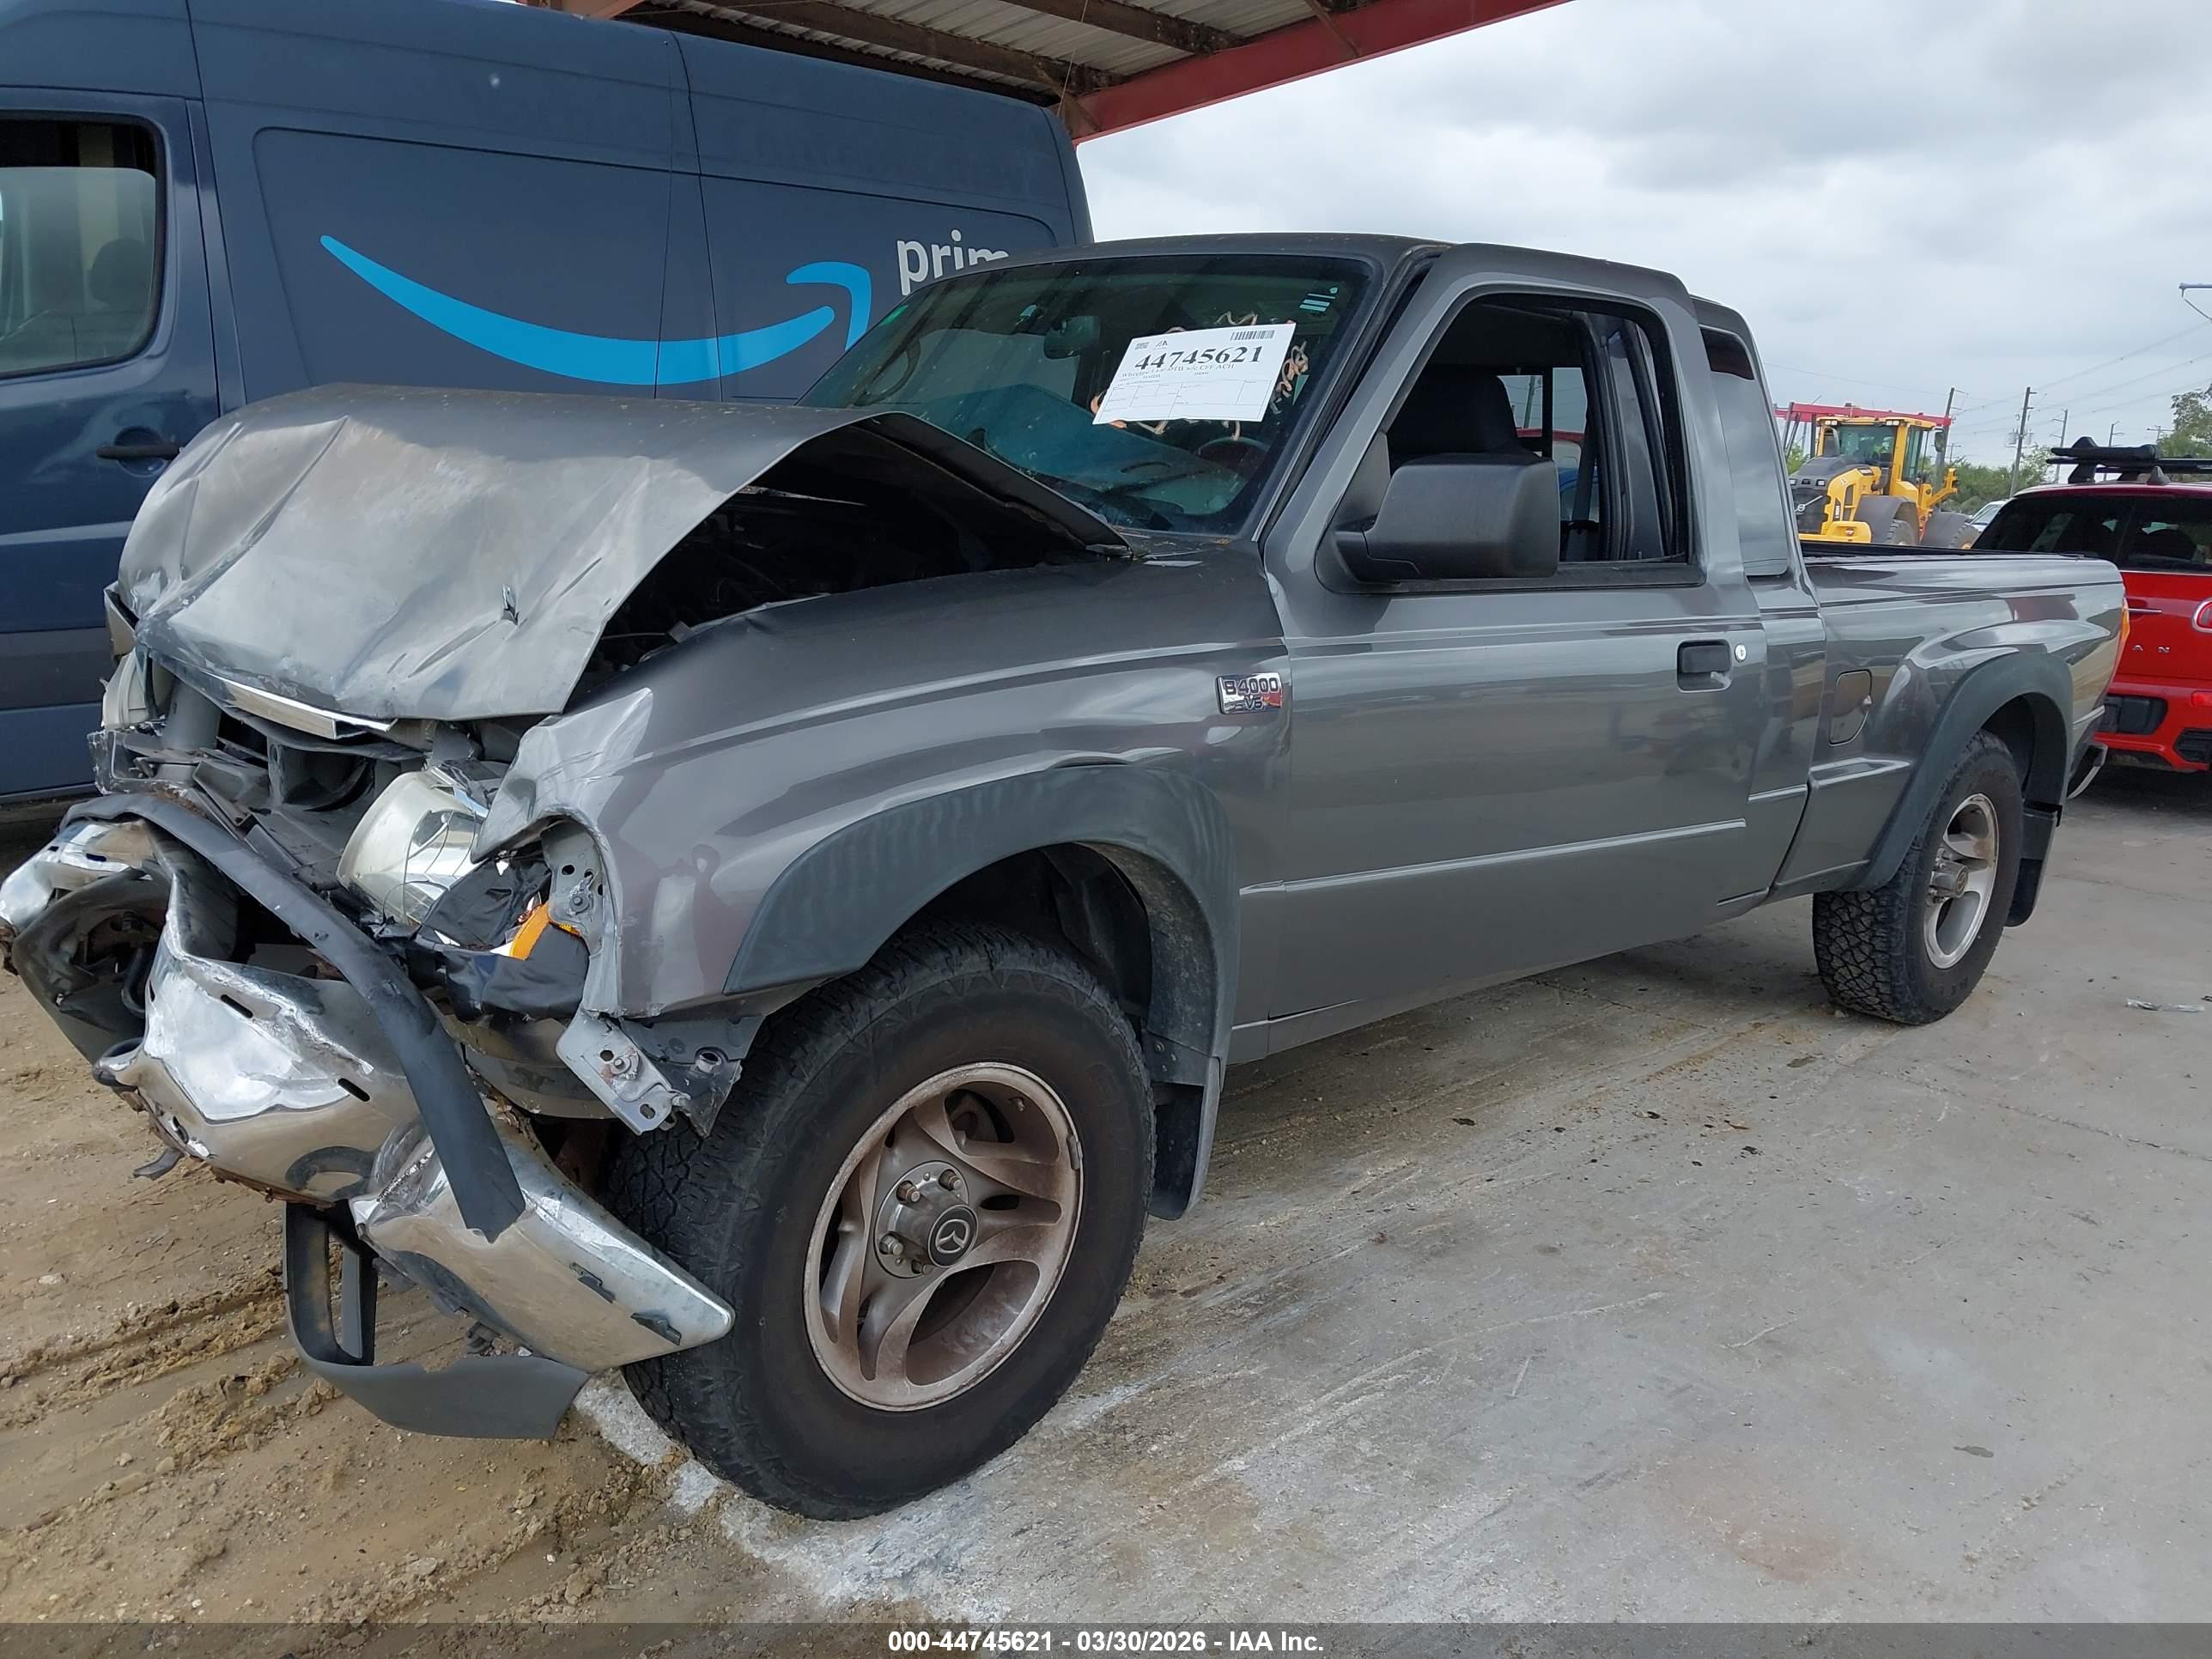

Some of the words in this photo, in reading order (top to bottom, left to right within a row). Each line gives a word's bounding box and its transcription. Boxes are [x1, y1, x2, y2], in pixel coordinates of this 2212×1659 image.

[1134, 345, 1263, 370] 44745621
[1224, 677, 1279, 696] B4000
[1244, 696, 1264, 710] V6
